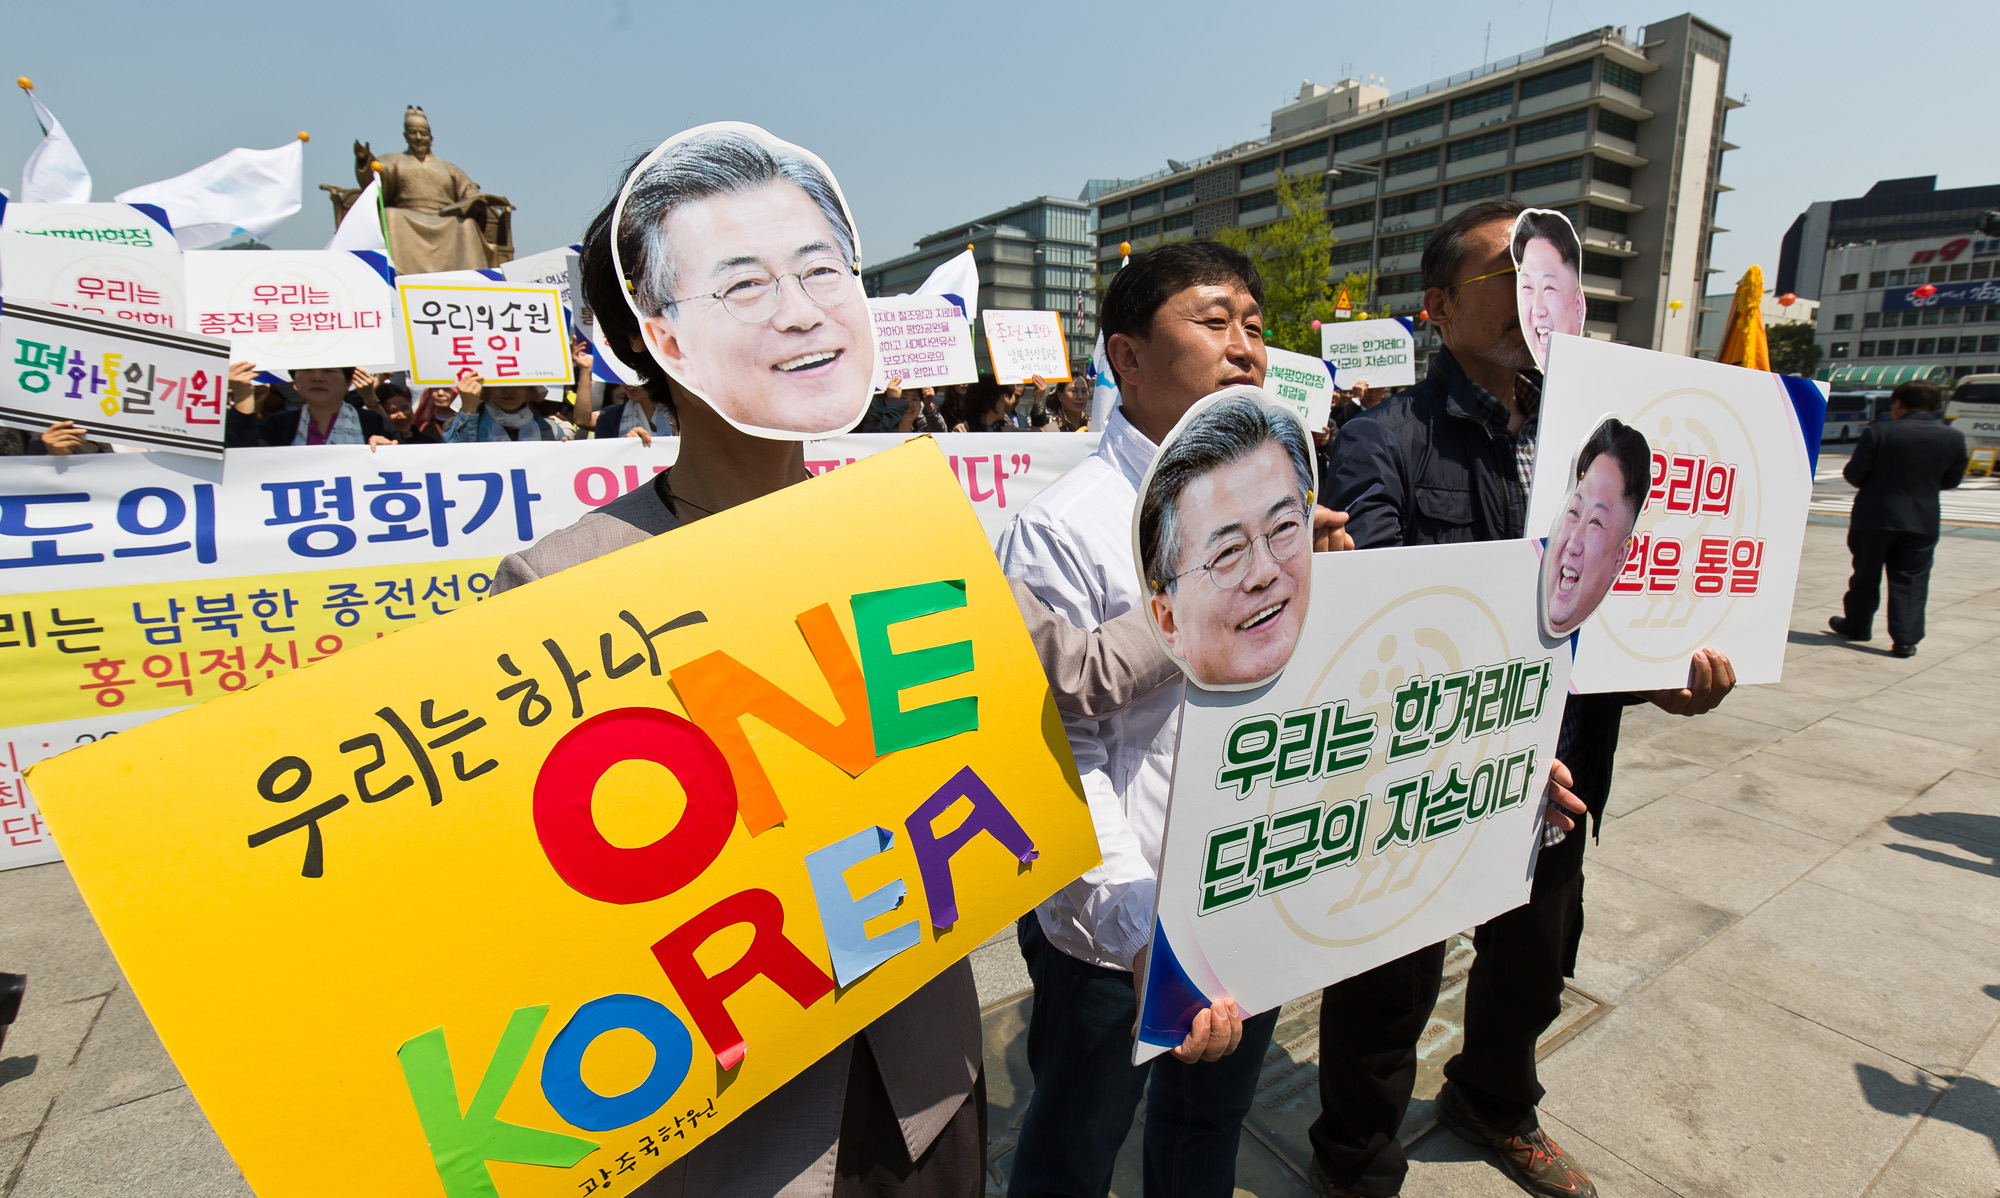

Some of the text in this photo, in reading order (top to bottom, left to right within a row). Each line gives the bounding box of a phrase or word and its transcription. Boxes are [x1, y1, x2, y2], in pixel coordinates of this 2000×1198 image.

[77, 277, 161, 305] 우리는
[253, 285, 330, 306] 우리는
[199, 312, 280, 335] 종전을
[289, 310, 382, 332] 원합니다
[413, 301, 495, 336] 우리의
[499, 301, 552, 334] 소원
[448, 334, 521, 383] 통일
[913, 365, 949, 378] 원합니다
[1329, 338, 1406, 354] 우리는 한겨레다
[1365, 354, 1408, 367] 자손이다
[1276, 383, 1308, 402] 체결을
[260, 467, 542, 559] 평화가
[1692, 534, 1767, 598] 통일
[132, 587, 300, 647] 남북한
[247, 609, 709, 878] 우리는 하나
[533, 578, 979, 905] ONE
[1215, 657, 1553, 801] 우리는 한겨레다
[1197, 745, 1538, 917] 단군의 자손이다
[396, 764, 1040, 1198] KOREA
[578, 1097, 719, 1198] 광주국학원
